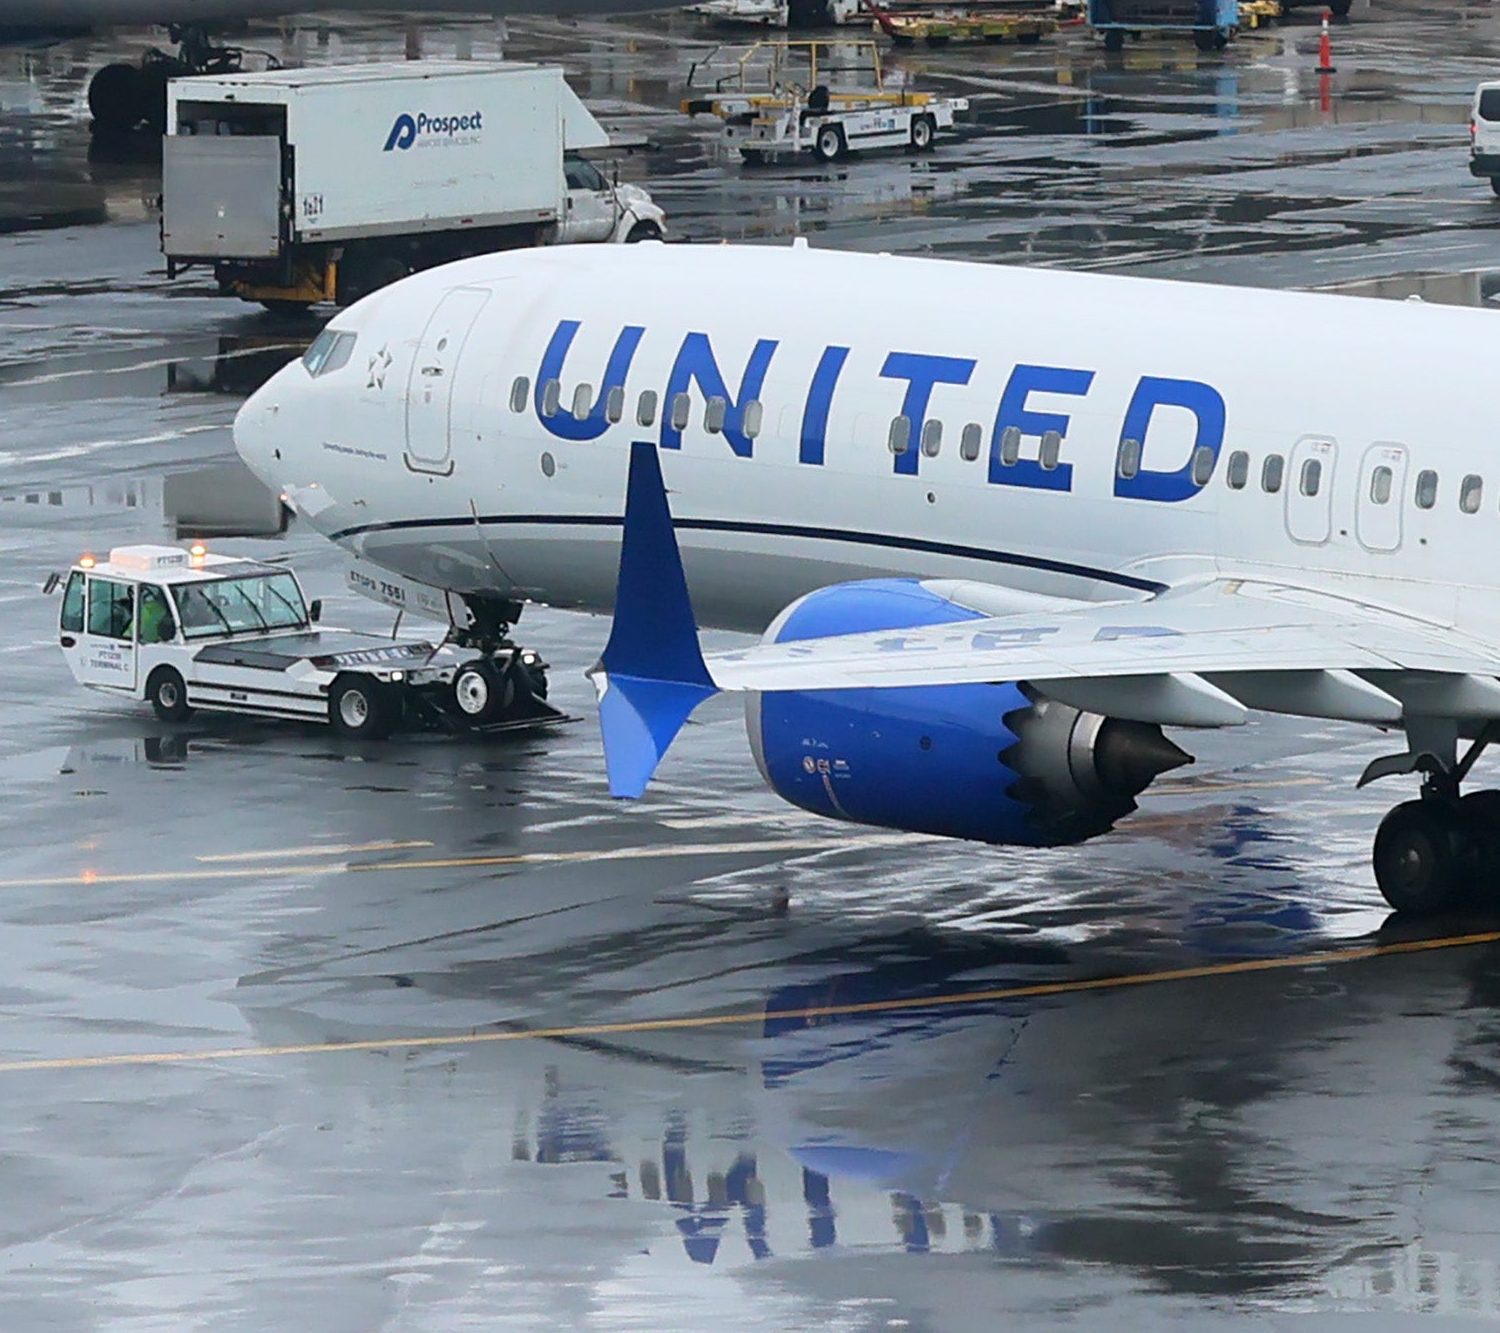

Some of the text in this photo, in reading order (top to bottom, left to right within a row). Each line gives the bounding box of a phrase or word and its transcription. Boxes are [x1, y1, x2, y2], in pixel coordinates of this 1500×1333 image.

[417, 110, 483, 137] Prospect
[534, 319, 1228, 503] UNITED
[379, 580, 406, 601] 7551
